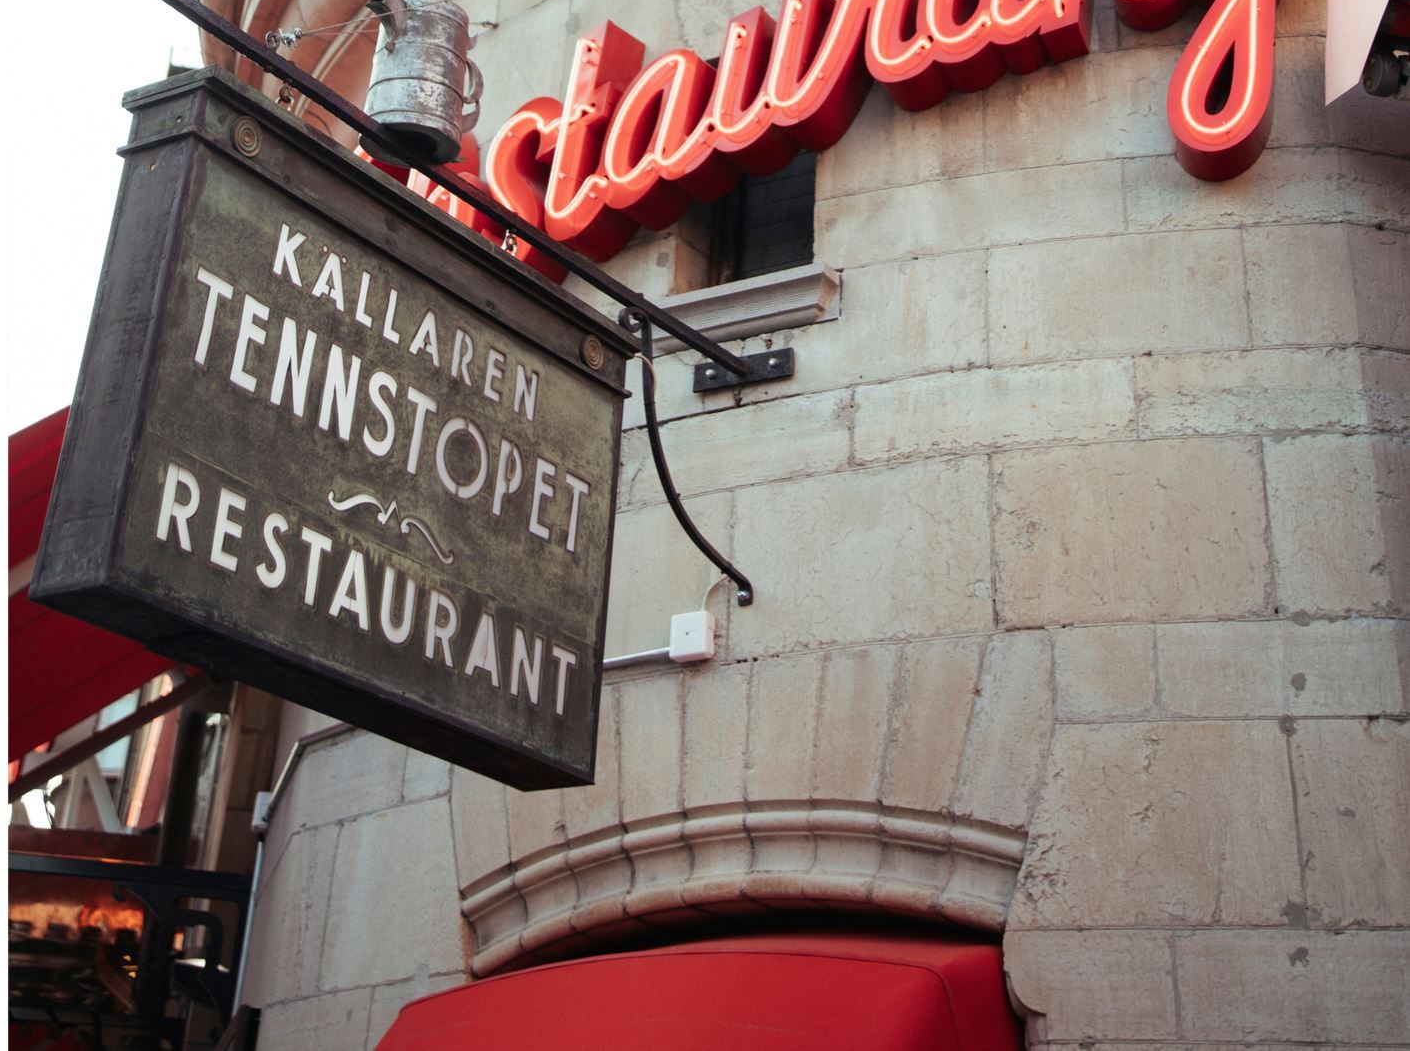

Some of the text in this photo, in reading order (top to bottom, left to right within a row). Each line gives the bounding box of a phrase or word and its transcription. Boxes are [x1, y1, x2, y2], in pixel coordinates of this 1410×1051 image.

[192, 266, 591, 553] TENNSTOPET
[272, 221, 540, 422] KÄLLAREN
[155, 460, 578, 717] RESTAURANT
